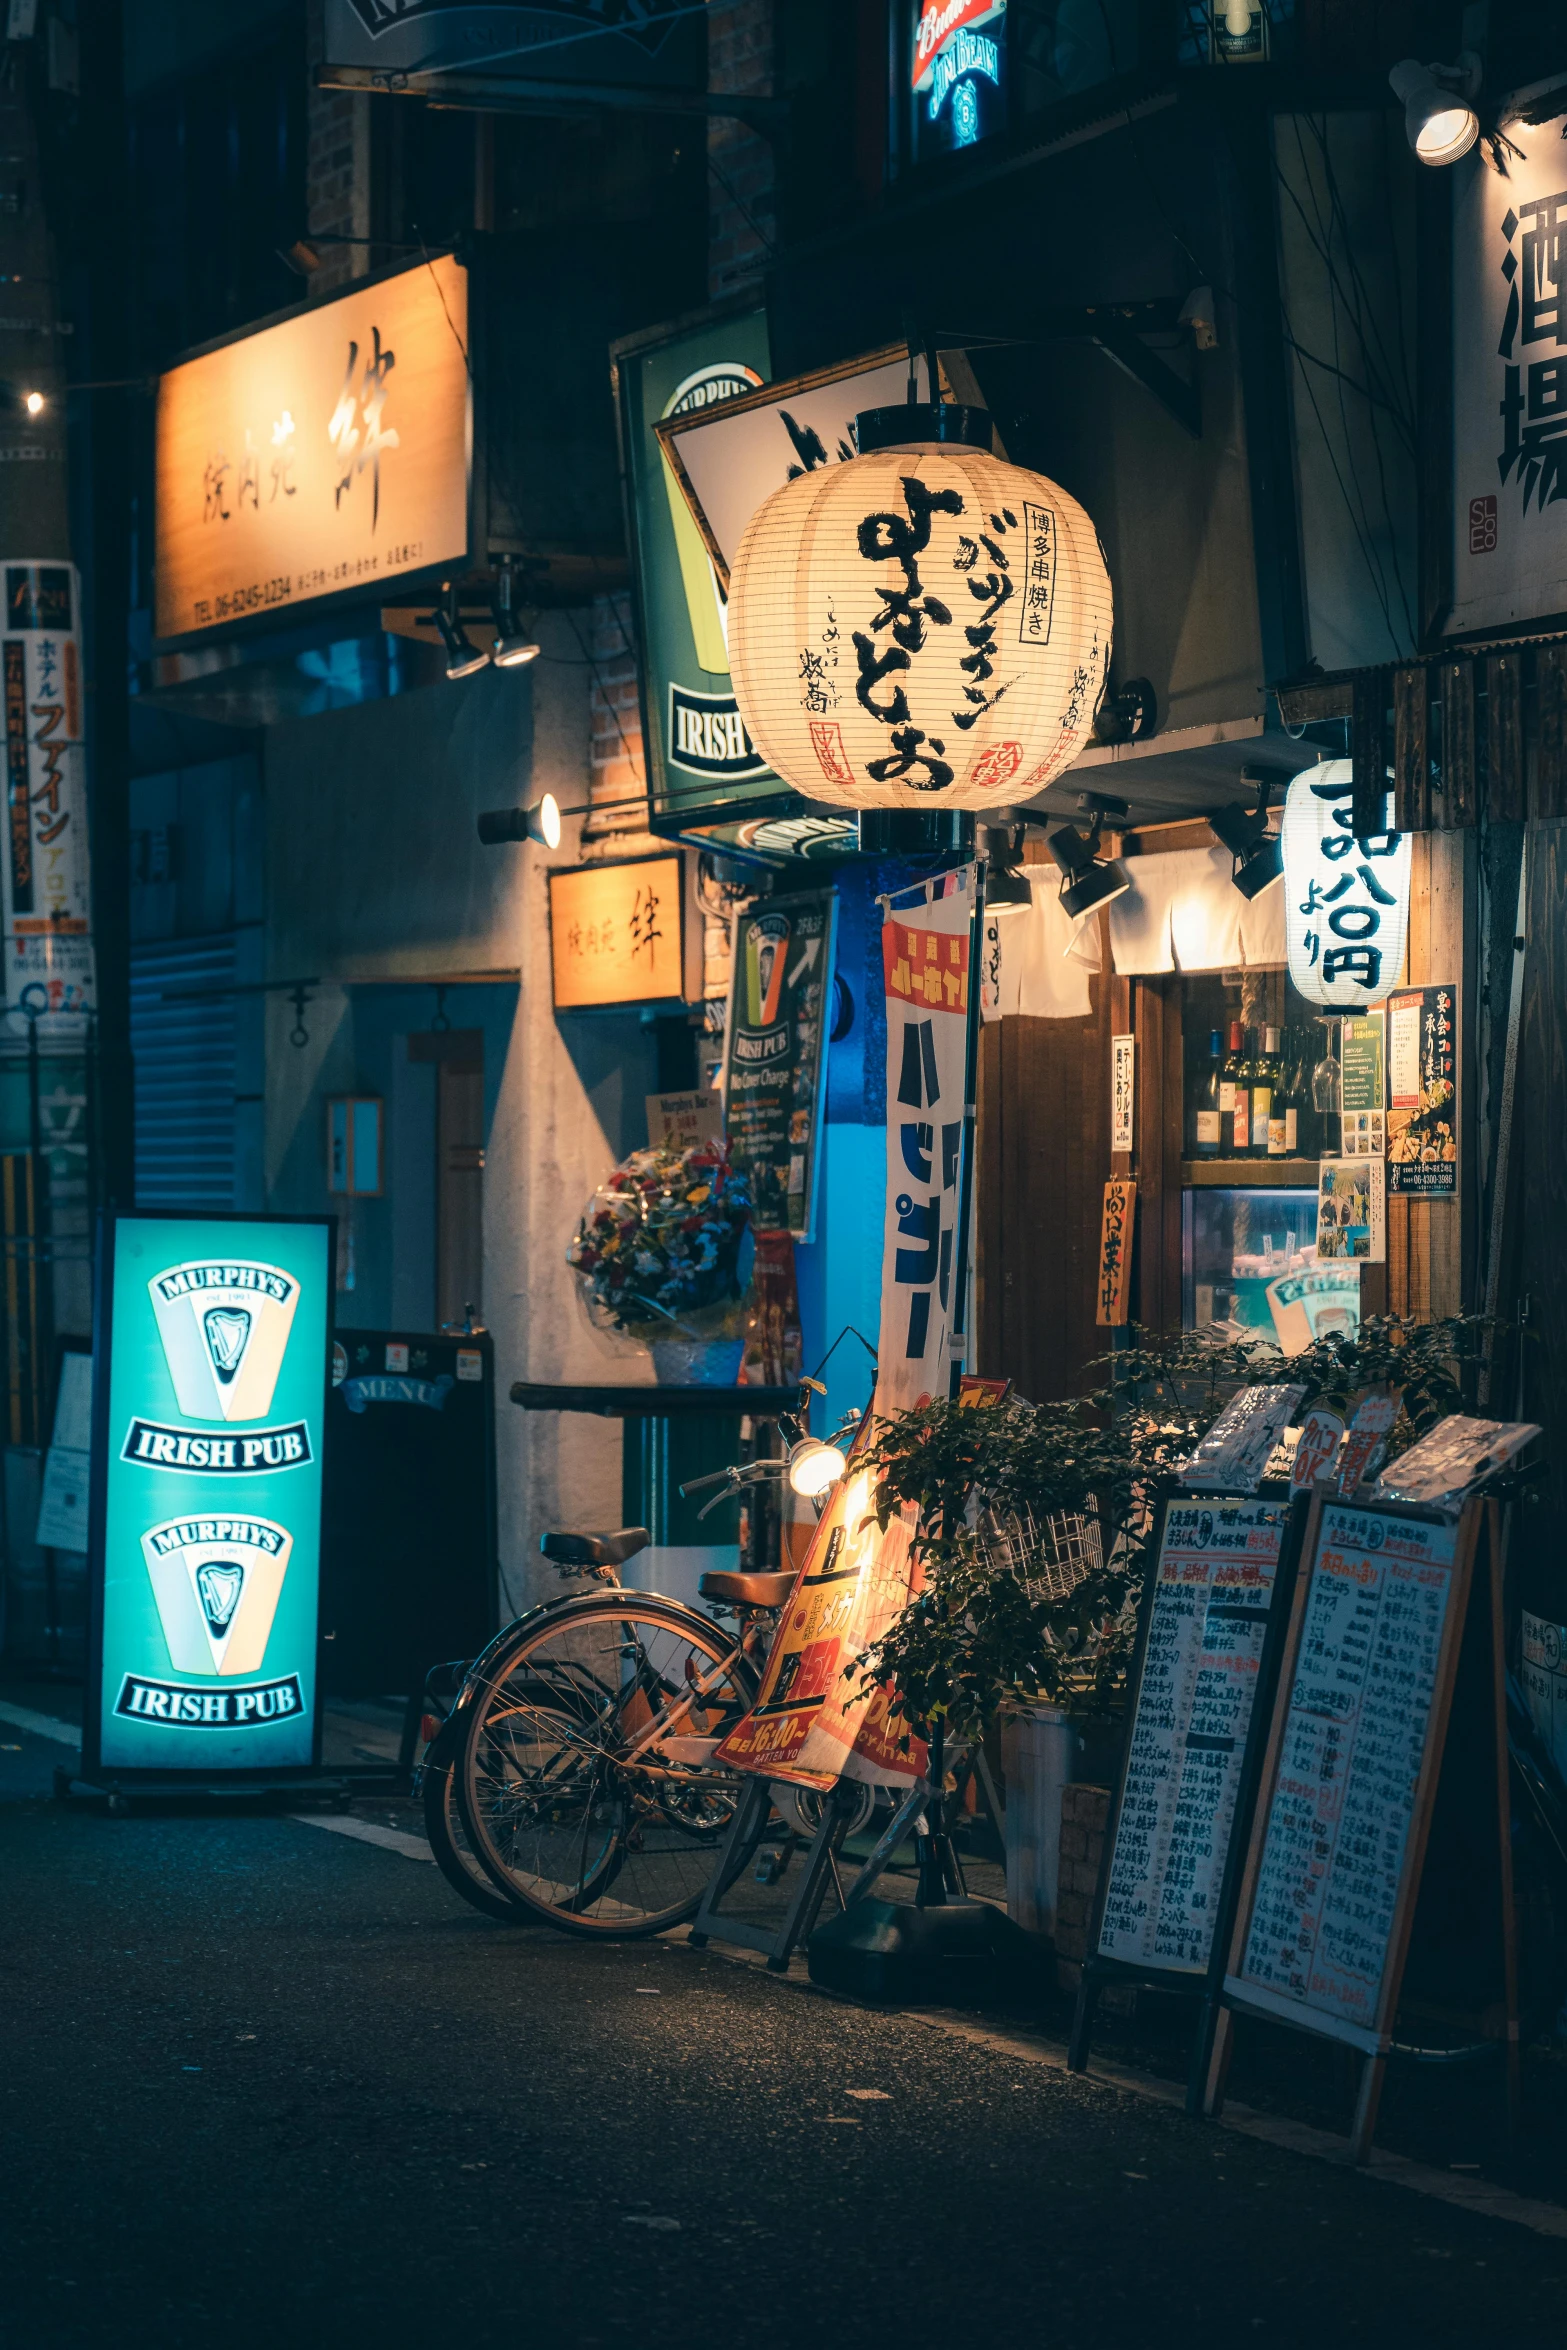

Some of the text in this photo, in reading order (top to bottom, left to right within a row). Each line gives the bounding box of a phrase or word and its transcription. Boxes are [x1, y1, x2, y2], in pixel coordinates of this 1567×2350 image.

[1027, 509, 1051, 636] 博多串焼き
[37, 639, 58, 698] ホテル
[676, 704, 749, 762] IRISH
[31, 704, 69, 844] ファイン
[1299, 878, 1324, 967] より
[736, 1031, 787, 1060] IRISH PUB
[1437, 990, 1448, 1096] 宴会コース
[760, 1068, 790, 1089] Charge
[161, 1266, 286, 1300] MURPHY'S
[357, 1379, 437, 1402] MENU
[133, 1429, 303, 1468] IRISH PUB
[1295, 1450, 1325, 1483] OK
[155, 1521, 279, 1553] MURPHY'S
[126, 1685, 296, 1722] IRISH PUB
[753, 1750, 785, 1765] BATTEN
